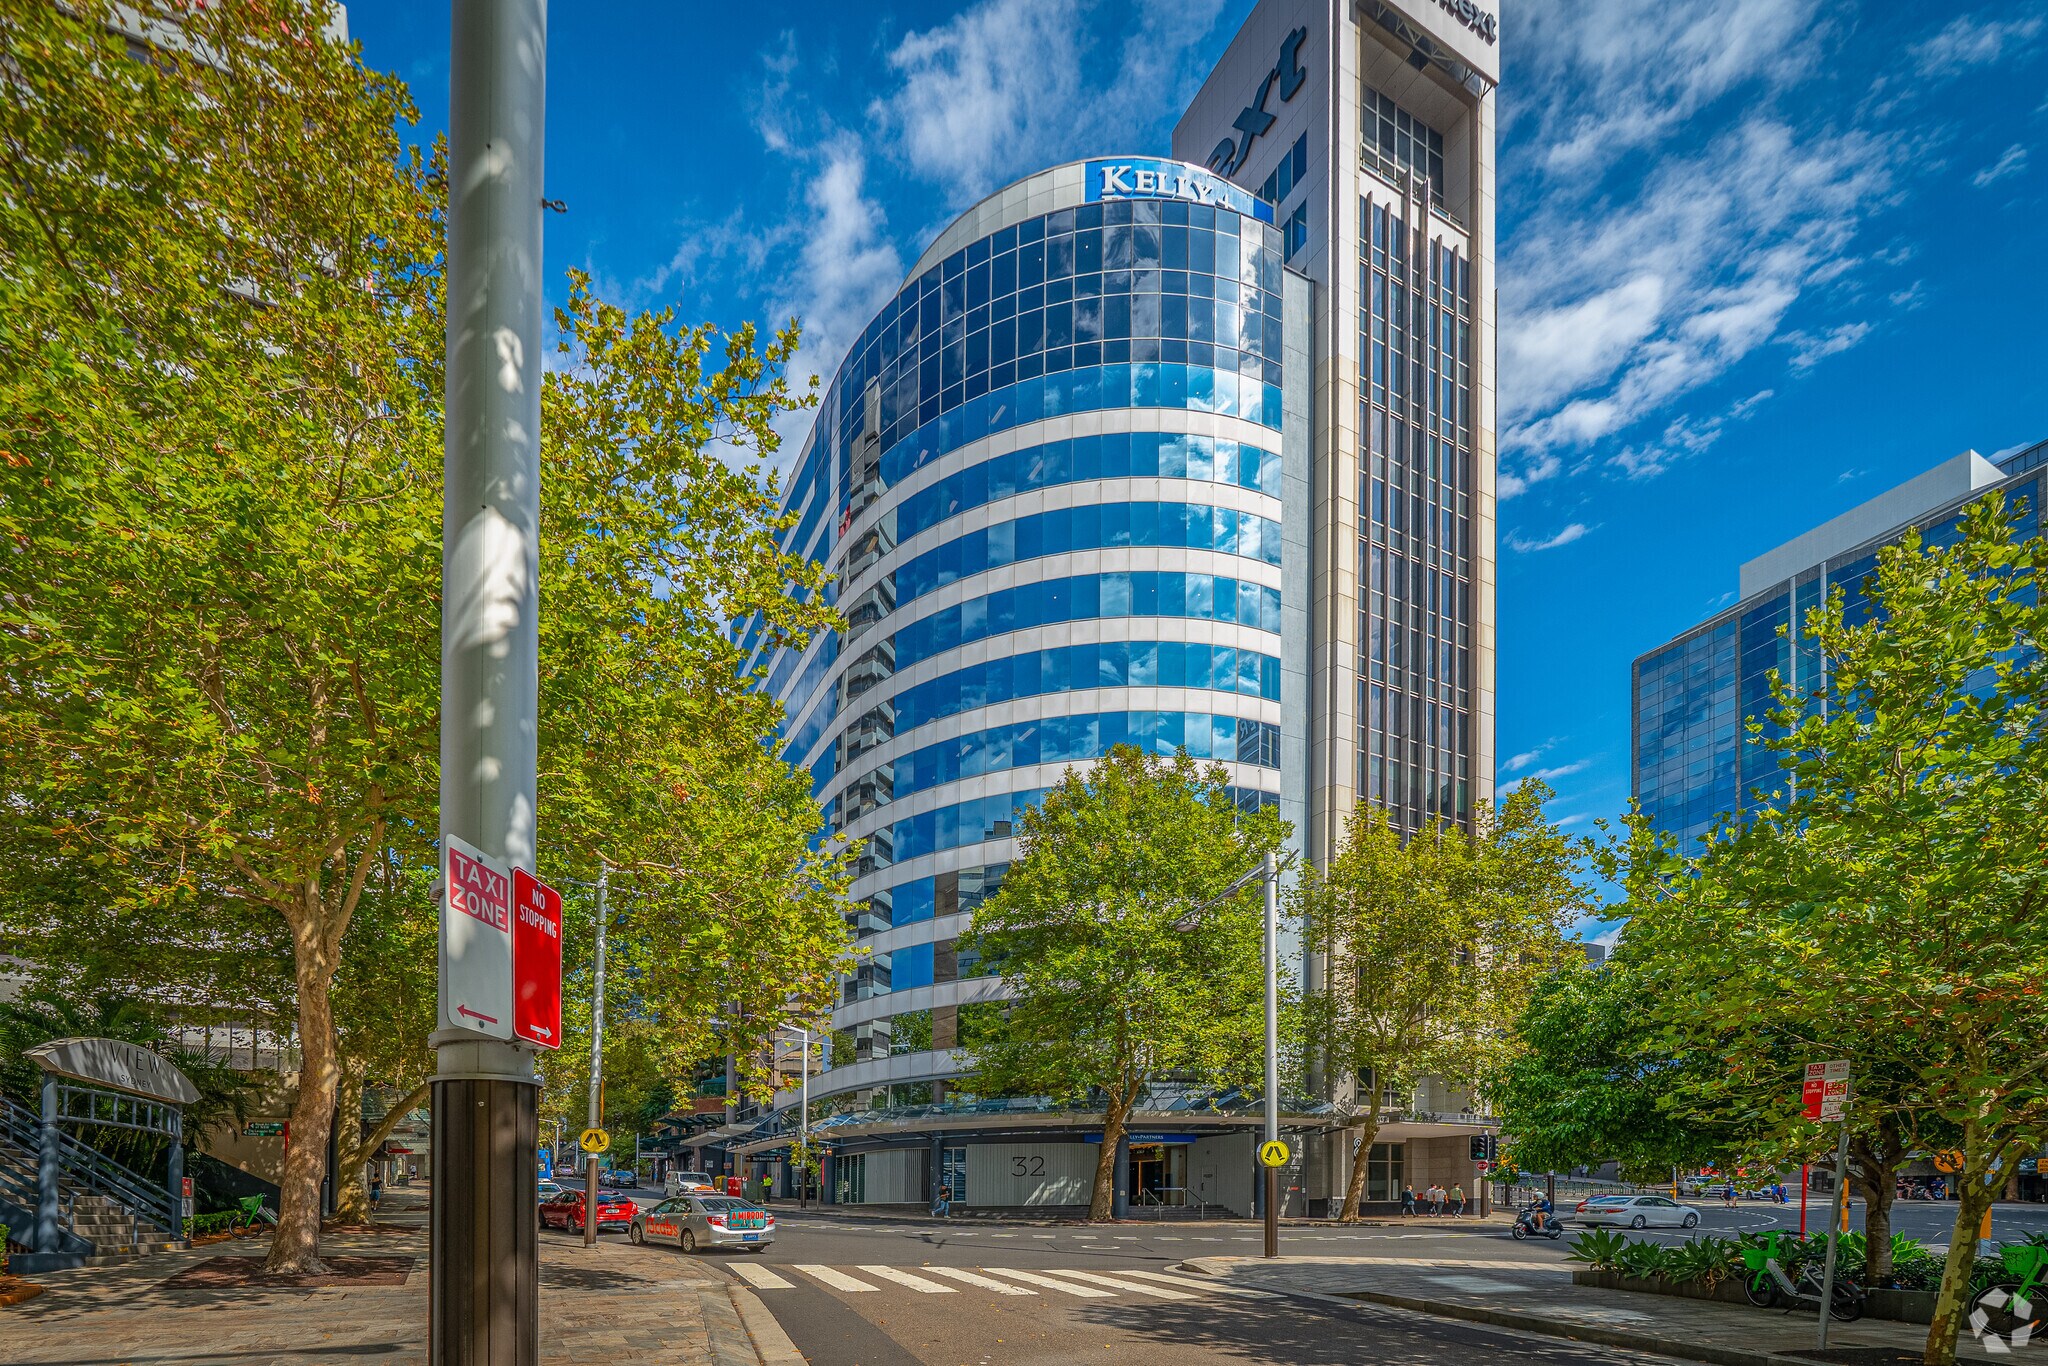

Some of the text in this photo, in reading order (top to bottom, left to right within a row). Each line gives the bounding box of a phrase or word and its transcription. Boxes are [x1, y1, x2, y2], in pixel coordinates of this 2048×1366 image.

[455, 855, 504, 901] TAXI
[452, 883, 507, 929] ZONE
[532, 888, 546, 910] NO
[519, 904, 557, 939] STOPPING
[110, 1041, 161, 1075] VIEW
[120, 1074, 151, 1089] SYDNEY
[1011, 1156, 1046, 1177] 32
[731, 1211, 764, 1220] A MIRROR
